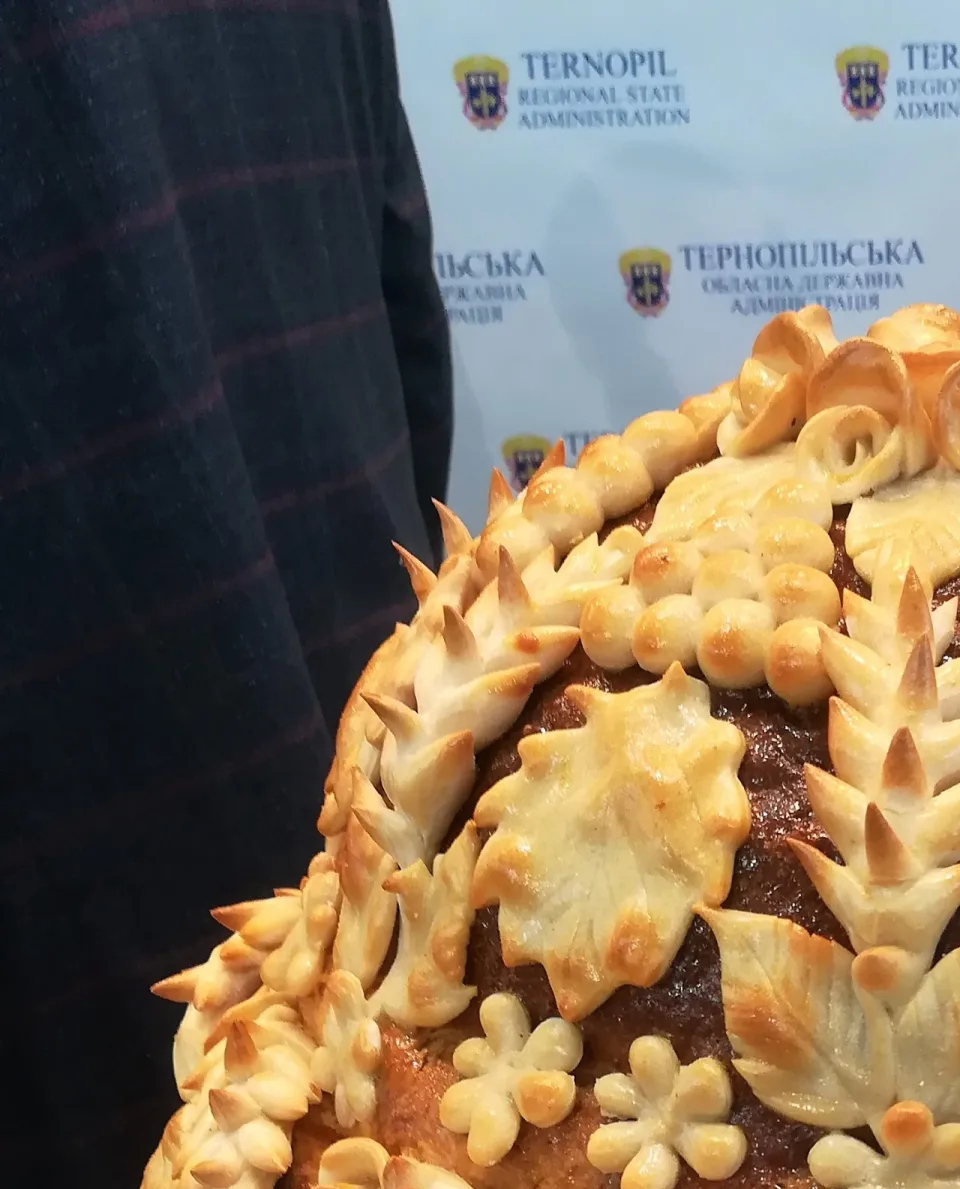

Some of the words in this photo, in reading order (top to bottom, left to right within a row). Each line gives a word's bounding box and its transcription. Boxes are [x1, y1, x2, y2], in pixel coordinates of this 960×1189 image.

[521, 49, 677, 80] TERNOPIL
[518, 84, 620, 105] REGIONAL
[625, 83, 685, 103] STATE
[518, 108, 691, 130] ADMINISTRATION
[678, 239, 925, 271] ТЕРНОПІЛЬСЬКА
